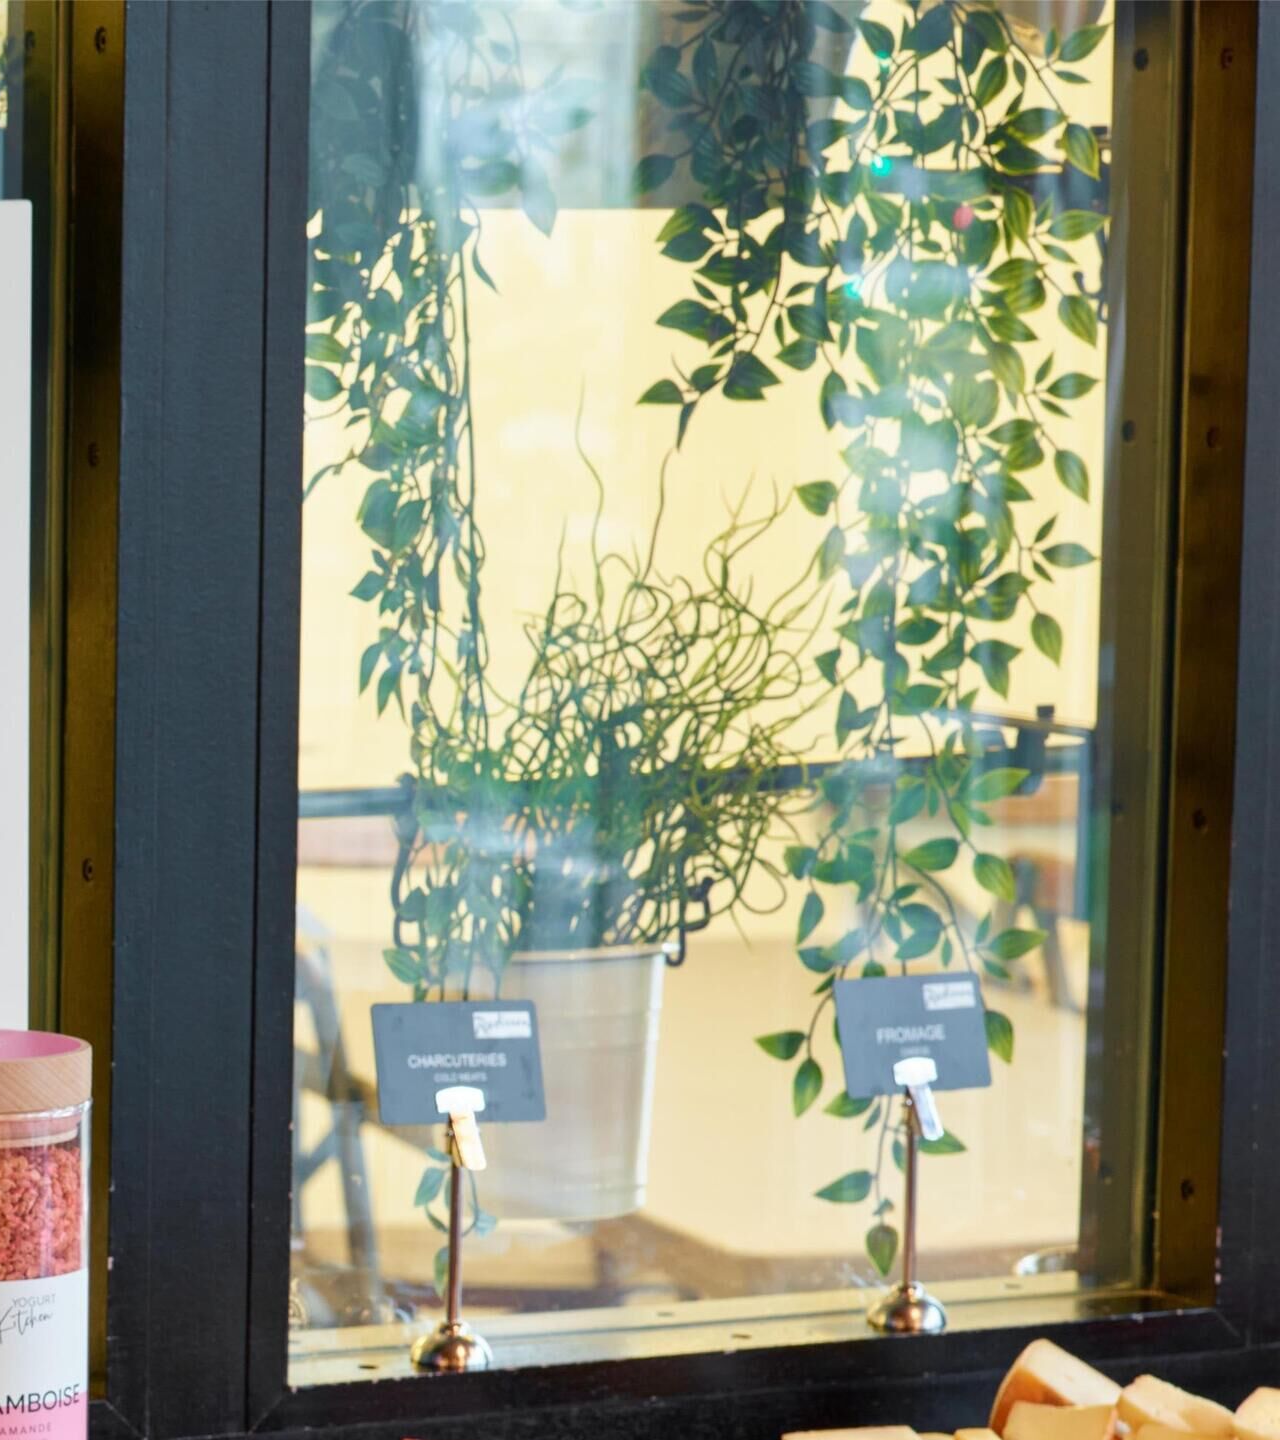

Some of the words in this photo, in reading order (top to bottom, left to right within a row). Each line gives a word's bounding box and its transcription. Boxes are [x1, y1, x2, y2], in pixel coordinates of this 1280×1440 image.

[876, 1024, 945, 1044] FROMAGE
[407, 1052, 507, 1069] CHARCUTERIES
[0, 1422, 52, 1436] AMANDE
